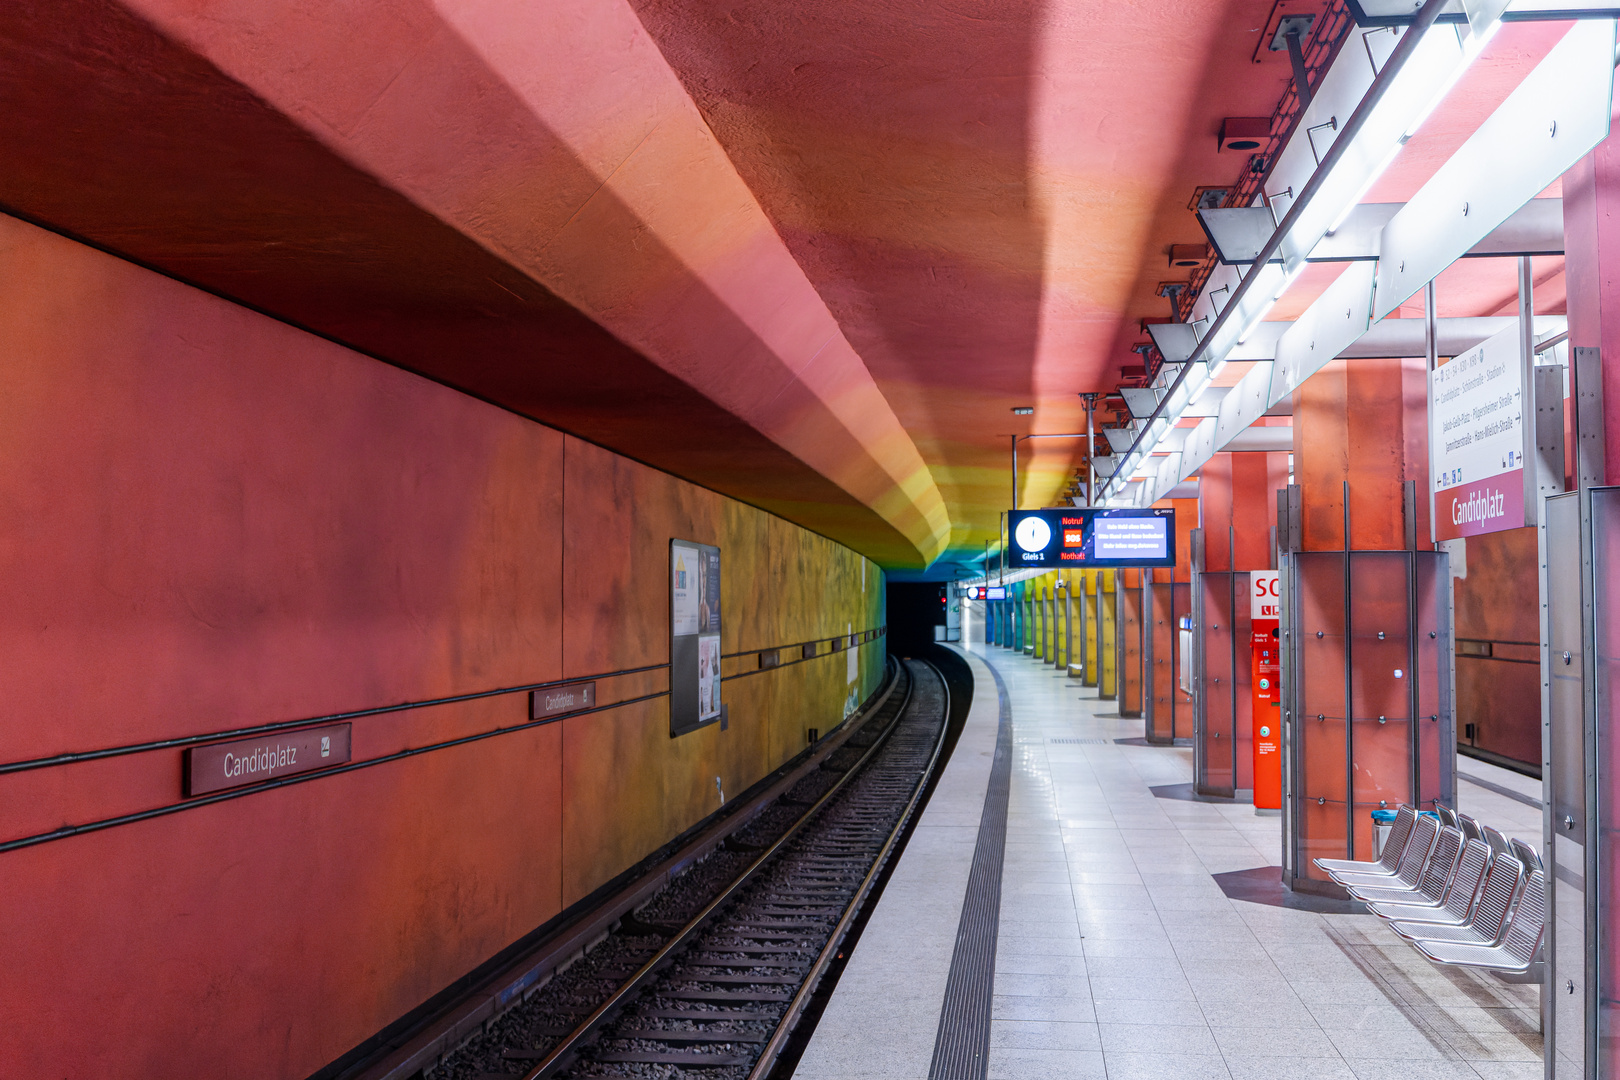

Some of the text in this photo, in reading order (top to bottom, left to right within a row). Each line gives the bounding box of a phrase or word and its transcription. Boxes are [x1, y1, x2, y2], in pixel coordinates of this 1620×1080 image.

[1441, 386, 1460, 404] Candidplatz
[1499, 392, 1513, 409] Straße
[1452, 487, 1505, 528] Candidplatz
[1061, 516, 1084, 525] Notruf
[1065, 534, 1081, 543] SOS
[1022, 552, 1045, 561] Gleis 1
[1060, 552, 1086, 560] Nothalt
[1255, 578, 1279, 597] SO
[546, 692, 574, 711] Candidplatz
[224, 744, 297, 778] Candidplatz
